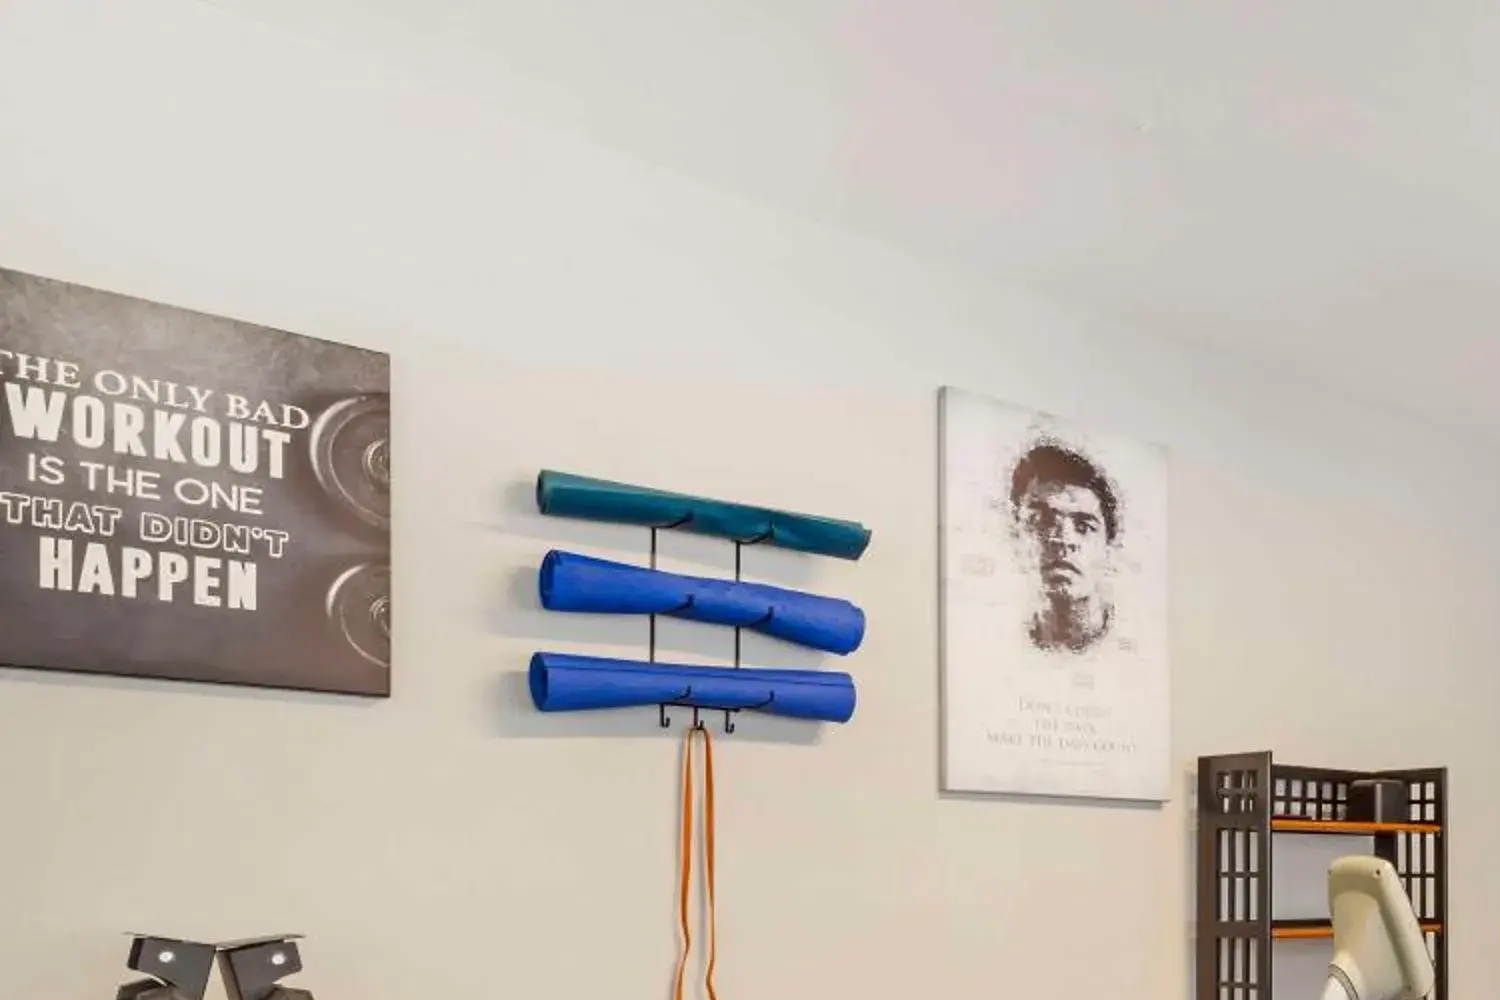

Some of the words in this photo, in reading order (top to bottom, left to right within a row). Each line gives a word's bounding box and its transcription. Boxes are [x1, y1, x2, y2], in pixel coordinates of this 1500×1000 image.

[5, 382, 291, 479] WORKOUT
[94, 369, 209, 416] ONLY
[226, 392, 311, 430] BAD
[28, 453, 65, 485] IS
[80, 460, 161, 500] THE
[174, 477, 263, 515] ONE
[0, 491, 123, 536] THAT
[140, 511, 288, 558] DIDN'T
[39, 536, 257, 611] HAPPEN
